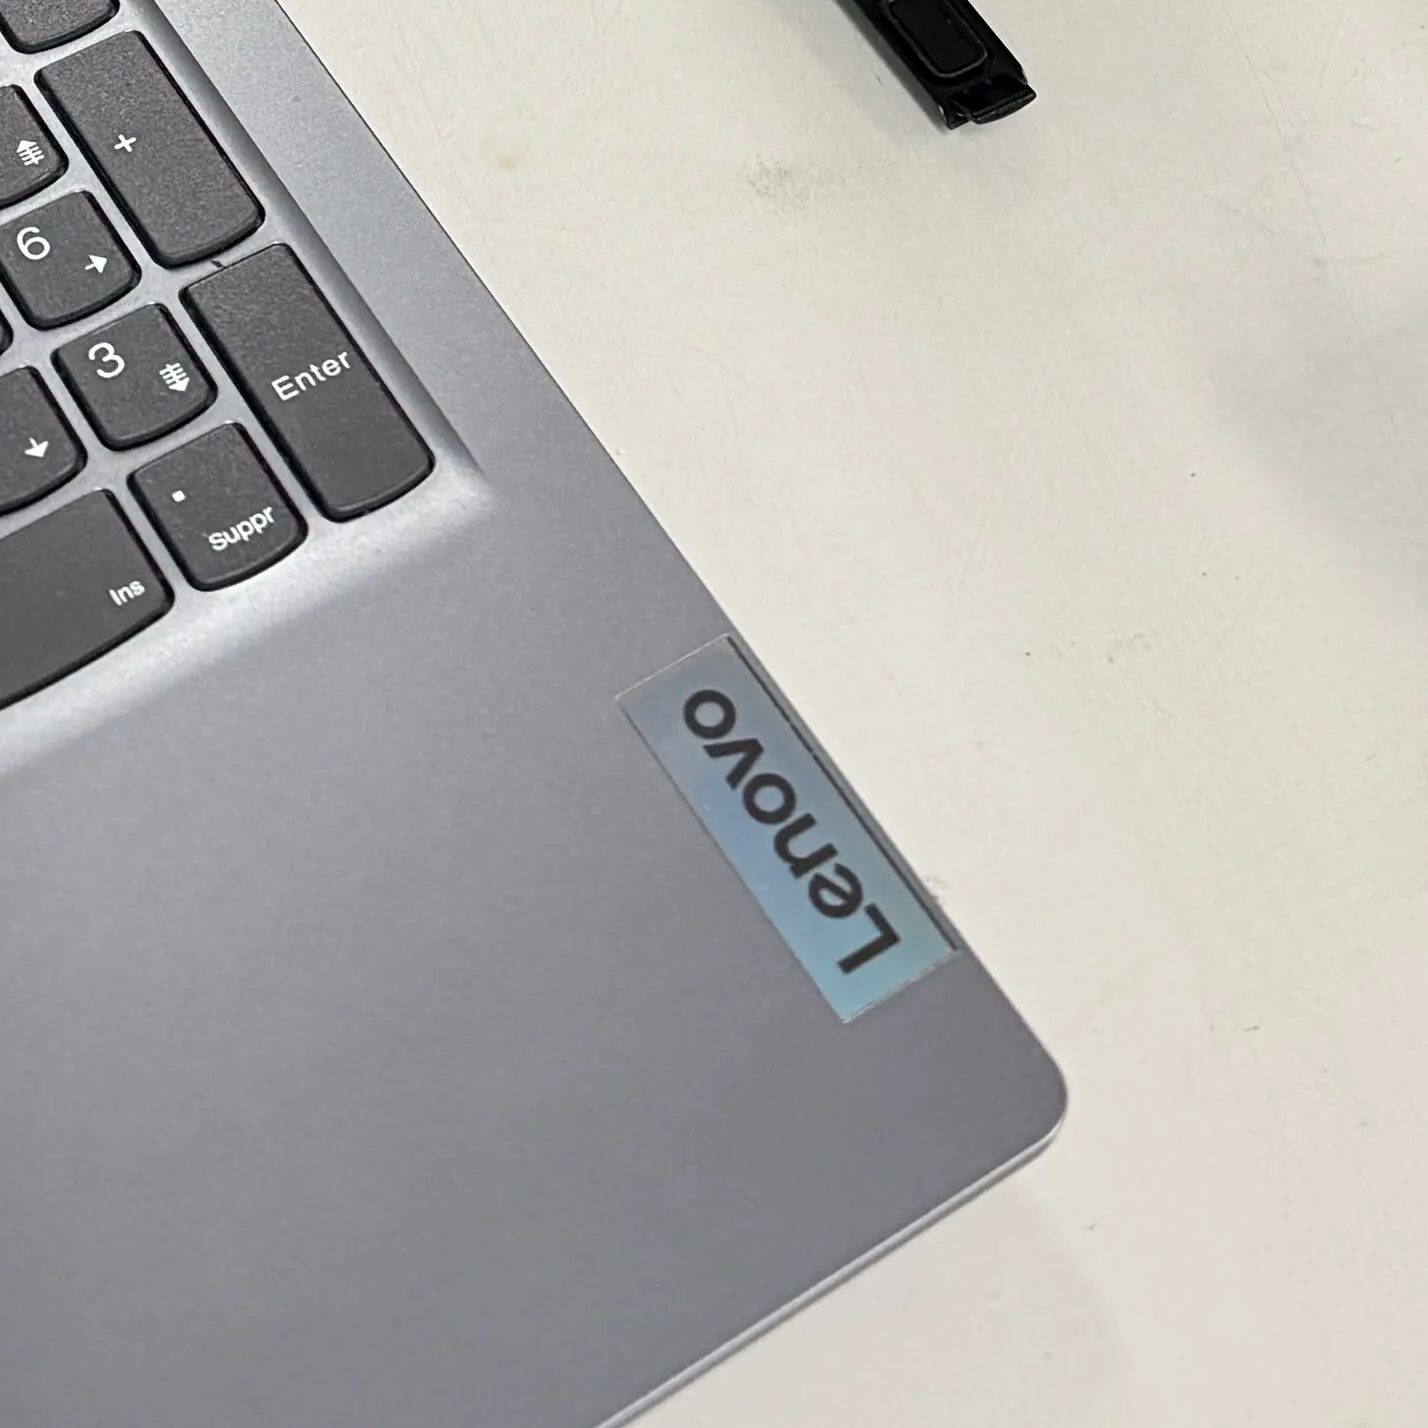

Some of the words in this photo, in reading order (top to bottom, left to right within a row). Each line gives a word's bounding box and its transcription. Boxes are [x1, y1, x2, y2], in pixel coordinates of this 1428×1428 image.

[88, 341, 126, 379] 3
[271, 350, 352, 403] Enter
[208, 505, 276, 553] Suppr
[109, 580, 145, 606] Ins
[682, 688, 902, 975] Lenovo
